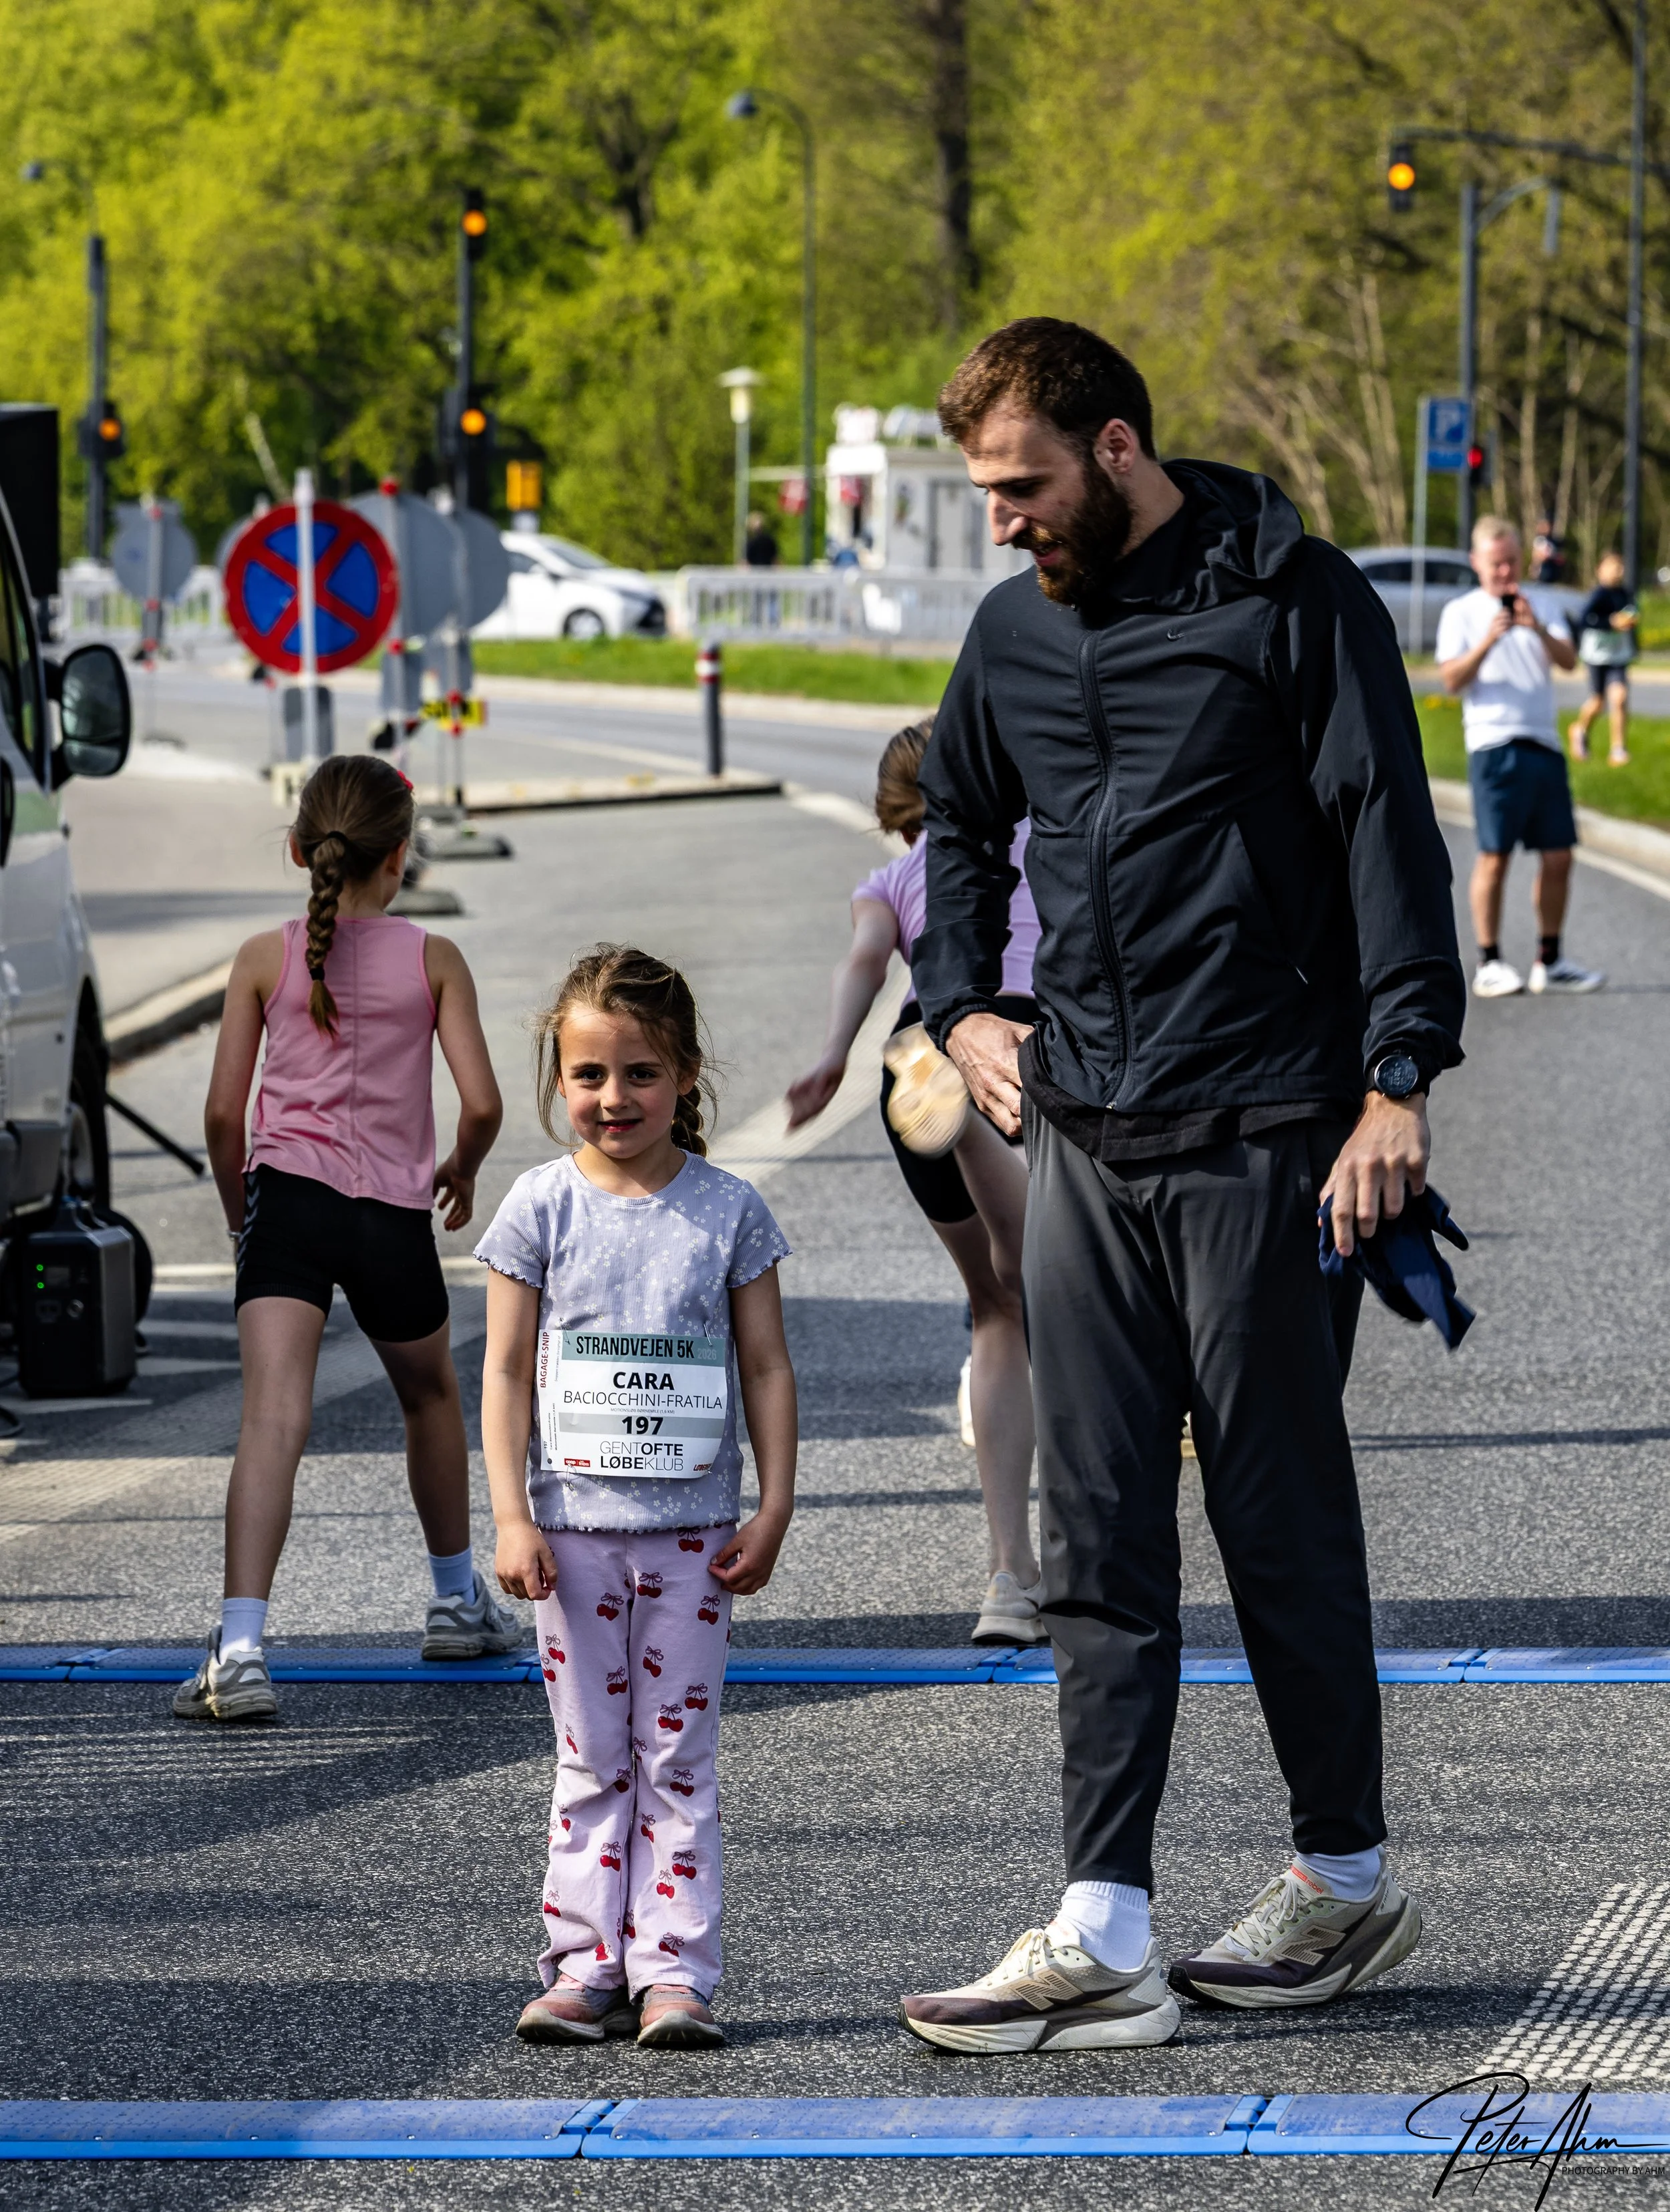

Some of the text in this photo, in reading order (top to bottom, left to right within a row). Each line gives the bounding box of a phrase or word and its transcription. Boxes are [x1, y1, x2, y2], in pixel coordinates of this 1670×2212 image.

[576, 1336, 717, 1361] STRANDVEJEN 5K 2026
[540, 1331, 550, 1388] BAGAGE-SNIP
[613, 1372, 675, 1391] CARA
[564, 1390, 723, 1410] BACIOCCHINI-FRATILA
[622, 1416, 664, 1436] 197
[600, 1440, 683, 1456] GENTOFTE
[600, 1456, 684, 1471] LØBEKLUB
[1306, 1878, 1324, 1895] rebel
